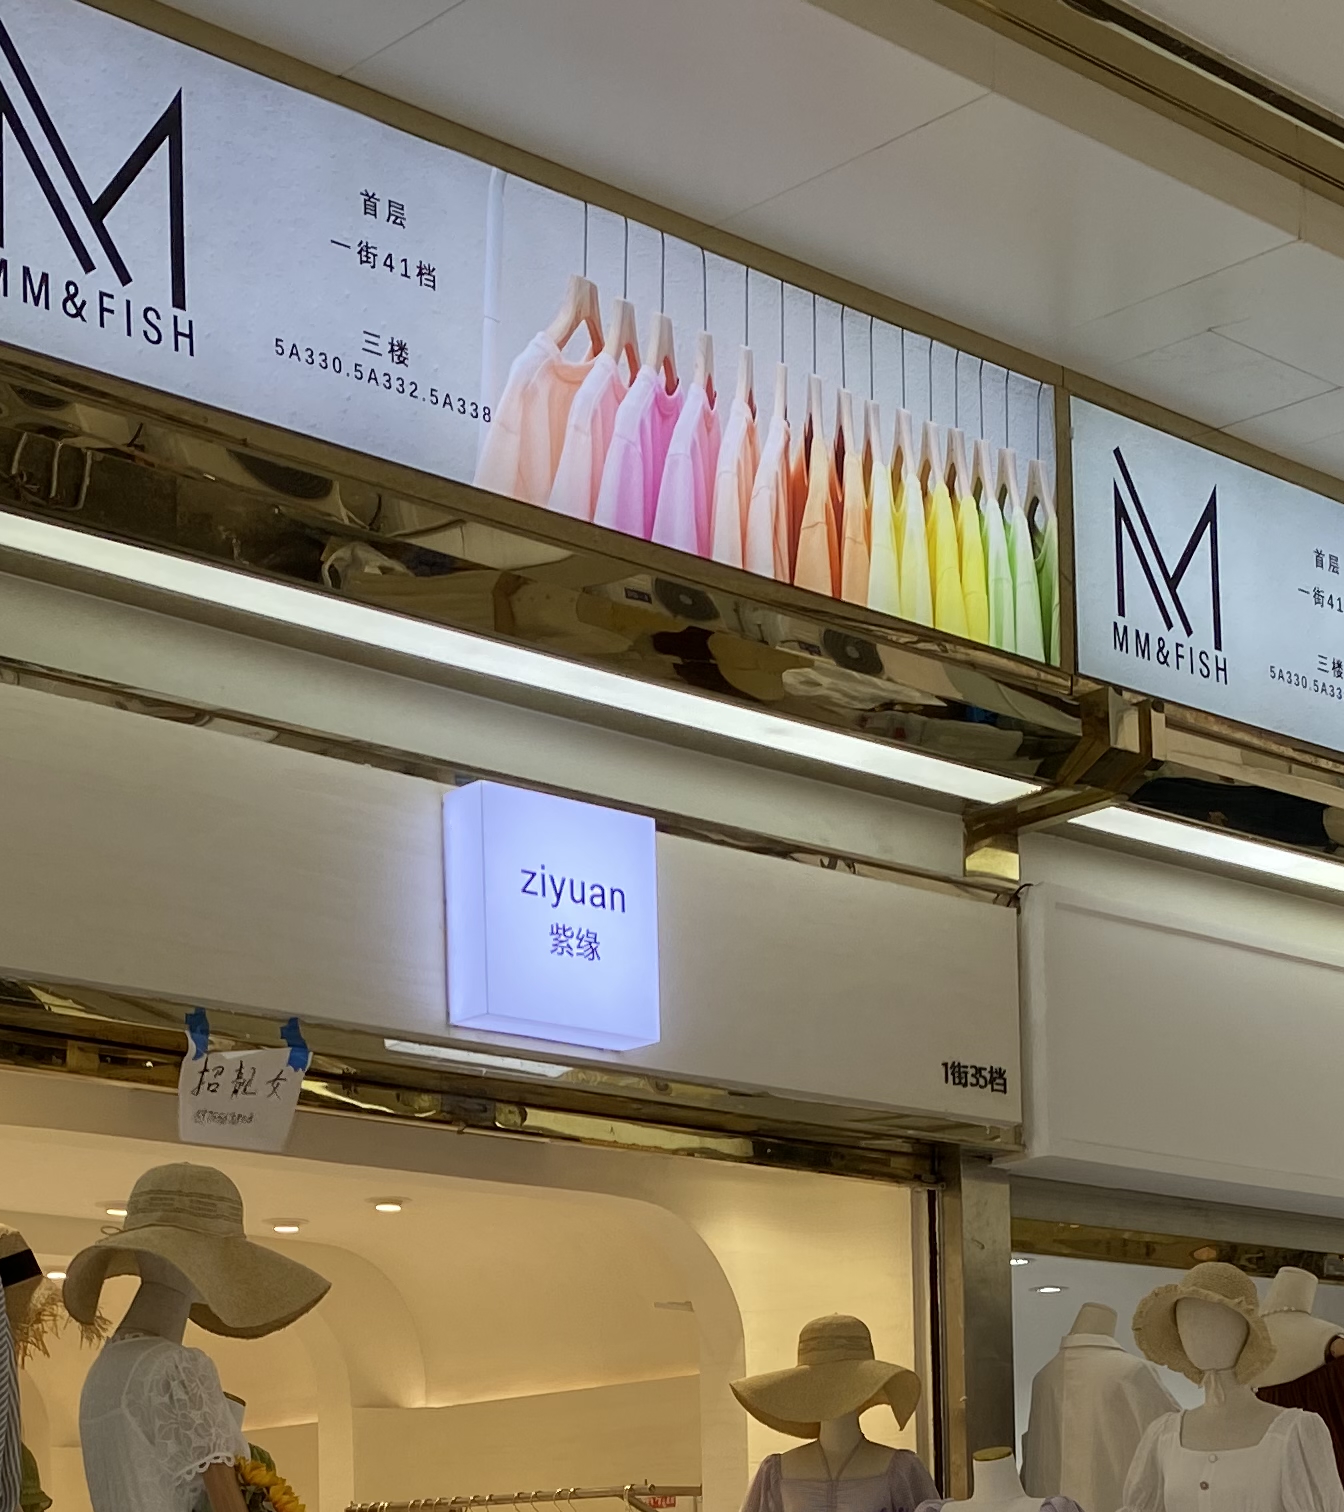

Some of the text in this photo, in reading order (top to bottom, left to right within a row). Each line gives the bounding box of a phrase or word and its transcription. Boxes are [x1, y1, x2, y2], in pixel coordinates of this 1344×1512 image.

[359, 188, 407, 230] 首层
[329, 238, 437, 292] 一街41档
[362, 330, 409, 368] 三楼
[274, 337, 492, 423] 5A330.5A332.5A338
[1313, 548, 1340, 575] 首层
[1112, 620, 1229, 686] MM&FISH
[1317, 654, 1344, 680] 三楼
[520, 864, 626, 913] ziyuan
[549, 922, 601, 961] 紫缘
[941, 1060, 1008, 1095] 1街35档
